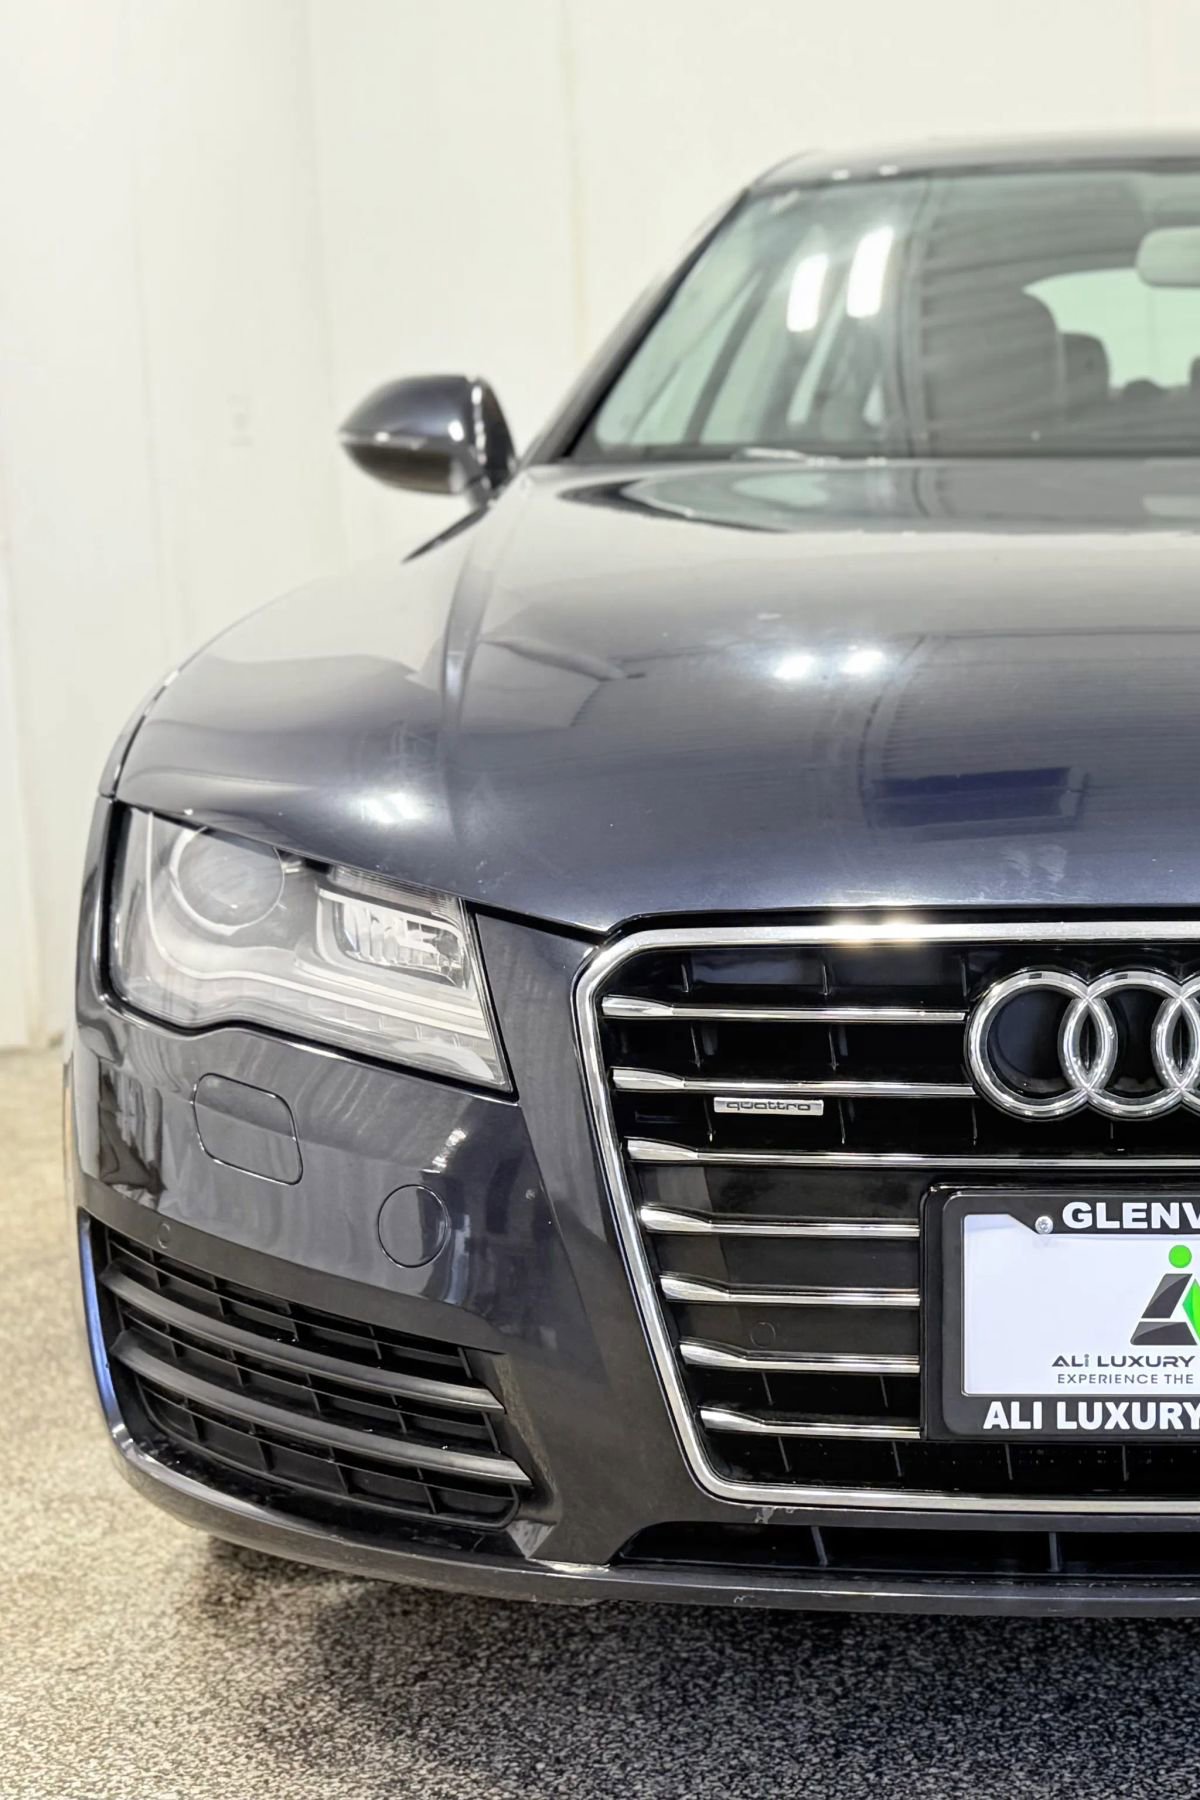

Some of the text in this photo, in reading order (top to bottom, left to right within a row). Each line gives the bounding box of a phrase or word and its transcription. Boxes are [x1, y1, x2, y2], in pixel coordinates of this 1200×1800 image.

[726, 1101, 811, 1111] quattro
[1097, 1355, 1196, 1368] LUXURY
[1057, 1373, 1158, 1385] EXPERIENCE
[1163, 1373, 1194, 1385] THE
[982, 1401, 1043, 1430] ALI
